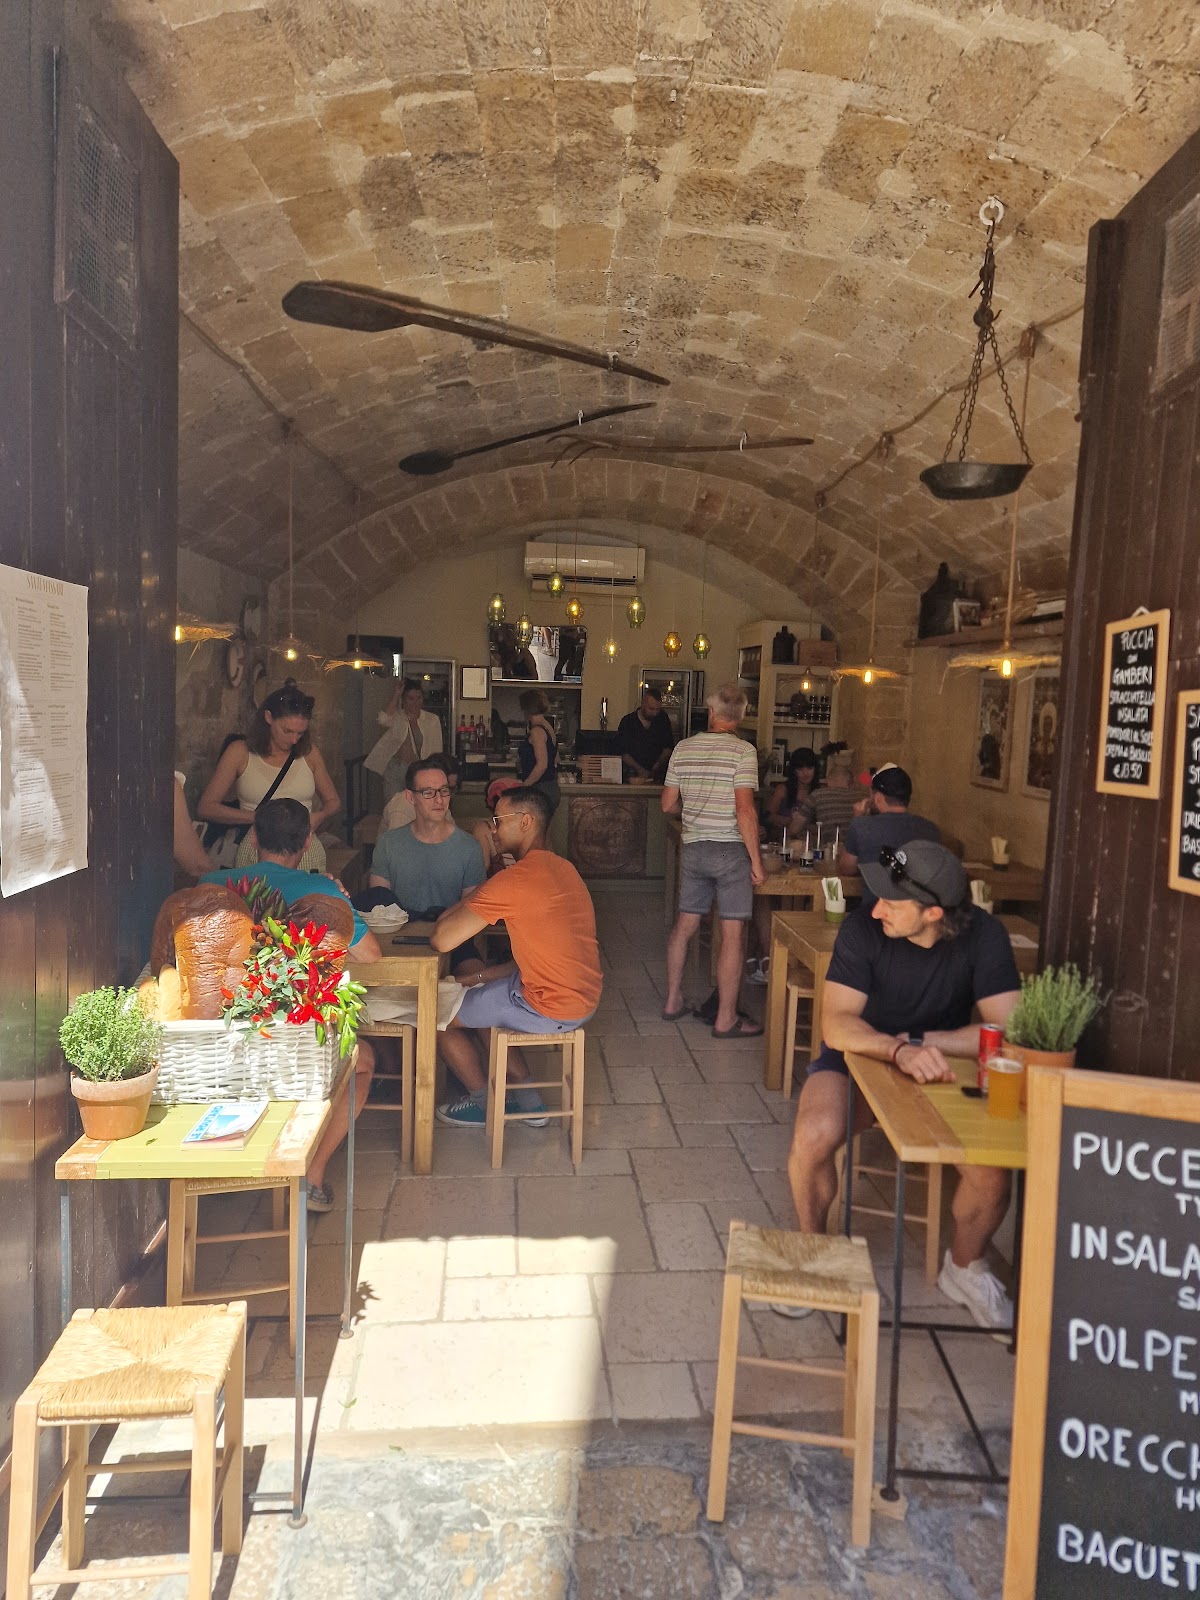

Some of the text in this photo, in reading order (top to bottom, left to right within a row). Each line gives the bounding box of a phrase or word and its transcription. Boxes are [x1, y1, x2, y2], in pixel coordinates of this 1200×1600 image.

[1120, 628, 1154, 651] PUCCIA
[1113, 666, 1153, 686] GAMBERI
[1073, 1132, 1200, 1188] PUCCE
[1070, 1223, 1200, 1280] INSALA
[1069, 1319, 1197, 1380] POLPE
[1057, 1524, 1200, 1591] BAGUET
